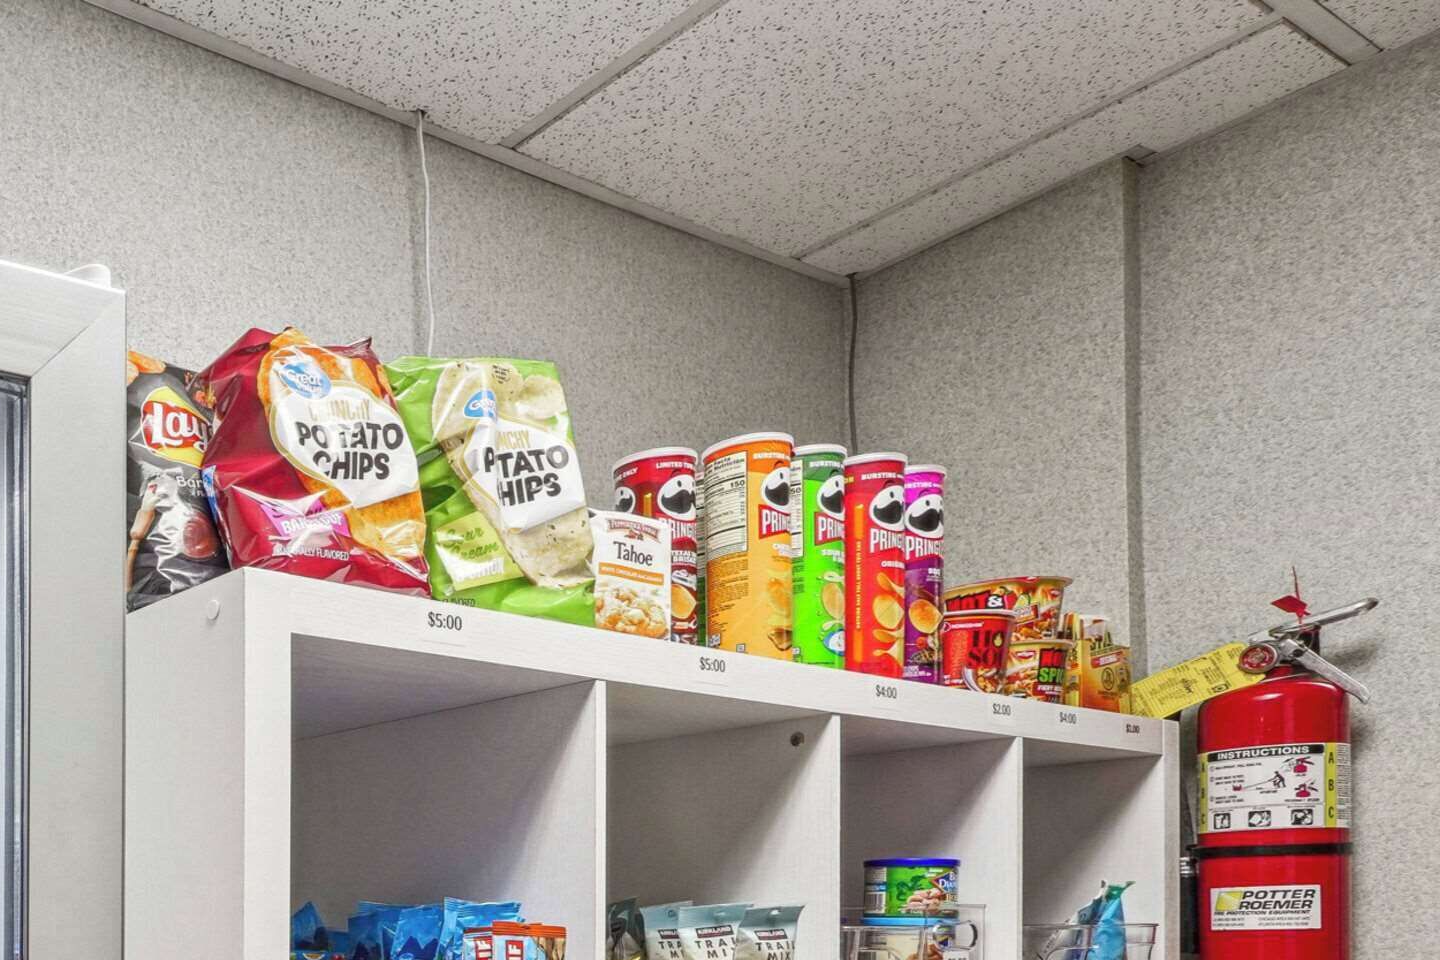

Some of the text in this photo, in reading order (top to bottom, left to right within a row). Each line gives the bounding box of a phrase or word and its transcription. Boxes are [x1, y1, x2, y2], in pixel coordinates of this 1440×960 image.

[313, 450, 391, 480] CHIPS
[484, 445, 569, 478] PTATO
[497, 473, 562, 507] HIPS
[613, 540, 653, 566] Tahoe
[427, 611, 463, 631] $5:00
[1217, 745, 1310, 760] INSTRUCTIONS
[1239, 900, 1313, 910] ROEMER
[1242, 889, 1316, 900] POTTER
